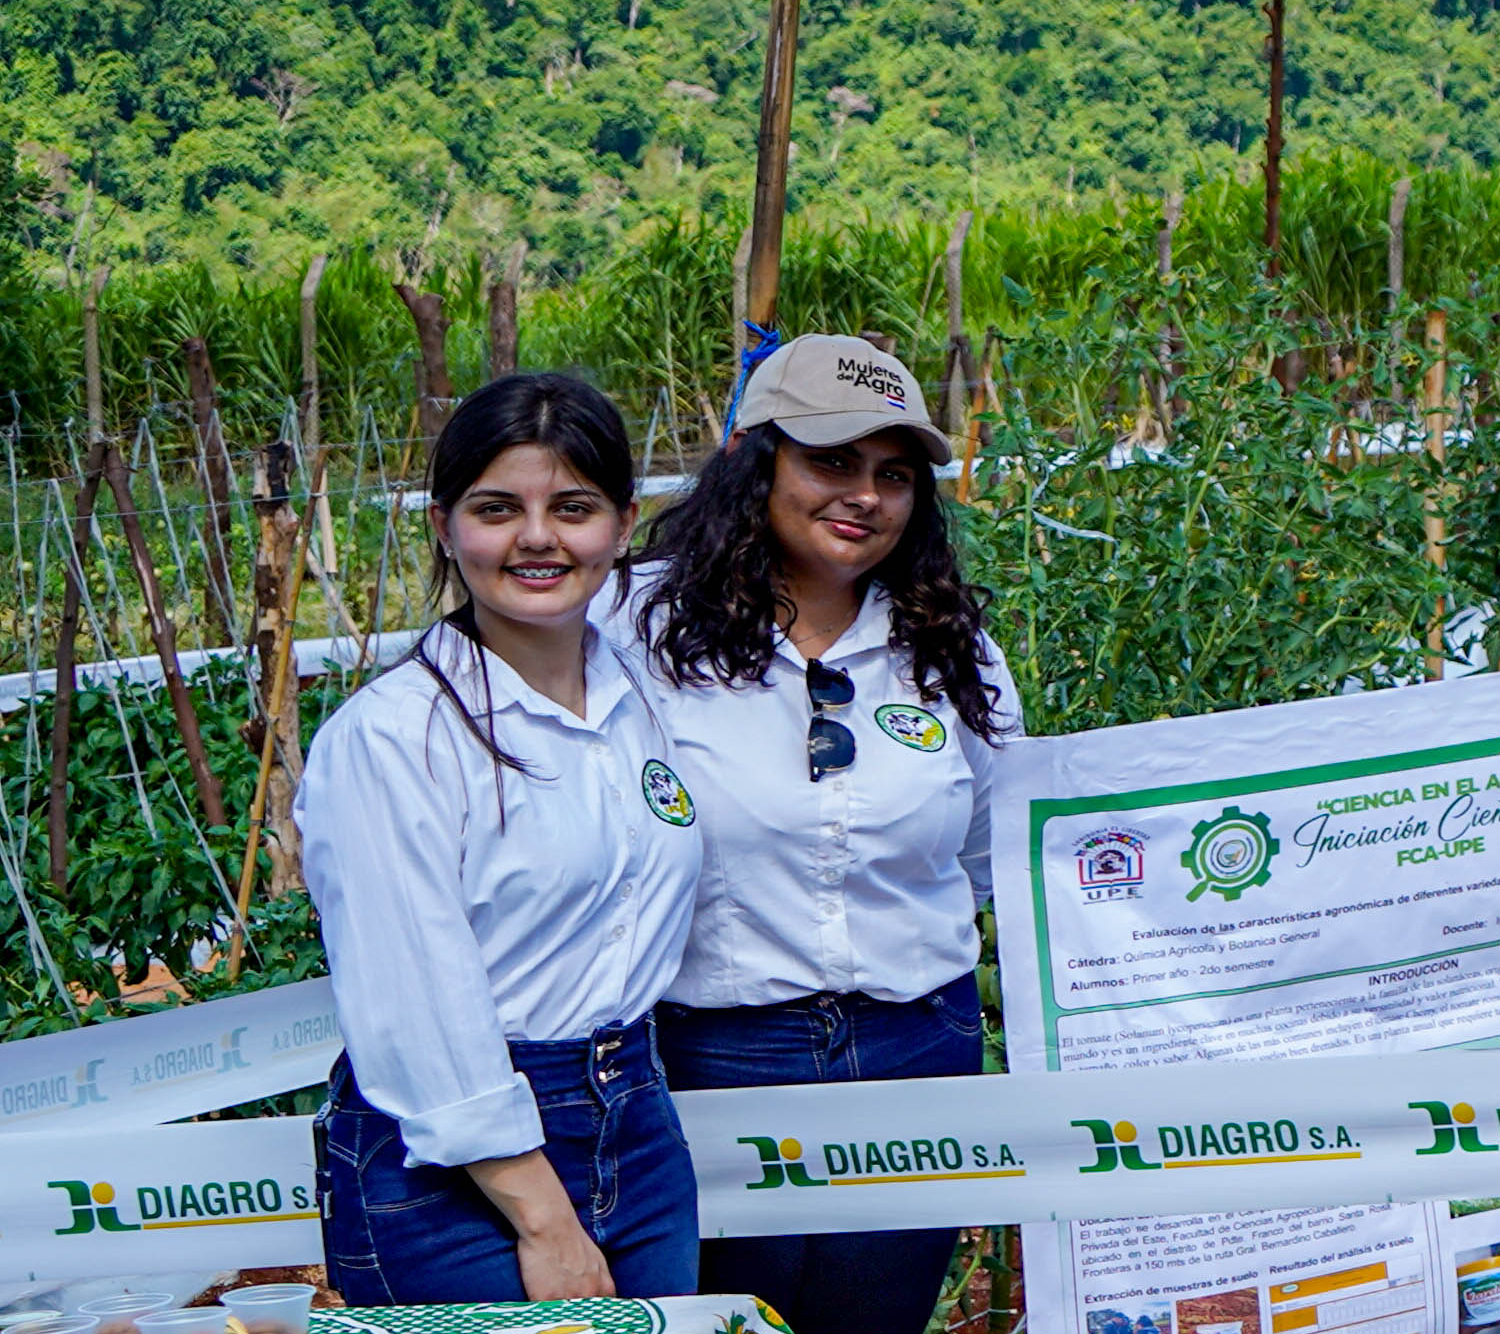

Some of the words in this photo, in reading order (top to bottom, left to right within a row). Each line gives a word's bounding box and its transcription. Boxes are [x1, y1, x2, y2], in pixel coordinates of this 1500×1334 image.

[836, 372, 855, 381] del
[853, 373, 905, 397] Agro
[838, 357, 903, 383] Mujeres
[1422, 781, 1449, 801] EN
[1456, 777, 1480, 794] EL
[1294, 813, 1430, 868] Iniciación
[1396, 836, 1486, 867] FCA-UPE
[1087, 887, 1141, 900] UPE
[1132, 925, 1198, 940] Evaluación
[1200, 924, 1216, 934] de
[1220, 922, 1236, 932] las
[1397, 894, 1410, 904] de
[1413, 885, 1464, 901] diferentes
[1442, 920, 1487, 935] Docente:
[1068, 956, 1120, 969] Cátedra:
[1279, 928, 1320, 944] General
[1070, 978, 1129, 991] Alumnos:
[1132, 973, 1166, 984] Primer
[1200, 964, 1222, 975] 2do
[1224, 958, 1275, 972] semestre
[823, 1137, 963, 1175] DIAGRO
[973, 1143, 1025, 1167] S.A.
[1158, 1119, 1299, 1159] DIAGRO
[1309, 1126, 1361, 1150] S.A.
[137, 1179, 282, 1220] DIAGRO
[1080, 1240, 1120, 1252] Privada
[1123, 1236, 1139, 1247] del
[1172, 1226, 1215, 1240] Facultad
[1218, 1224, 1231, 1234] de
[1233, 1216, 1274, 1230] Ciencias
[1081, 1252, 1122, 1266] ubicado
[1128, 1250, 1142, 1259] en
[1163, 1243, 1197, 1255] distrito
[1202, 1240, 1216, 1250] de
[1252, 1228, 1284, 1240] Franco
[1288, 1221, 1303, 1233] del
[1339, 1209, 1364, 1221] Santa
[1095, 1225, 1132, 1237] trabajo
[1154, 1216, 1204, 1231] desarrolla
[1082, 1265, 1135, 1278] Fronteras
[1145, 1259, 1164, 1269] 150
[1188, 1255, 1201, 1264] de
[1203, 1253, 1212, 1262] la
[1214, 1249, 1234, 1260] ruta
[1261, 1234, 1312, 1250] Bernardino
[1313, 1224, 1356, 1240] Caballero
[1269, 1257, 1318, 1275] Resultado
[1320, 1252, 1335, 1264] del
[1375, 1241, 1386, 1252] de
[1389, 1235, 1414, 1248] suelo
[1084, 1287, 1143, 1304] Extracción
[1146, 1285, 1160, 1295] de
[1162, 1280, 1213, 1293] muestras
[1215, 1276, 1229, 1286] de
[1231, 1270, 1258, 1283] suelo
